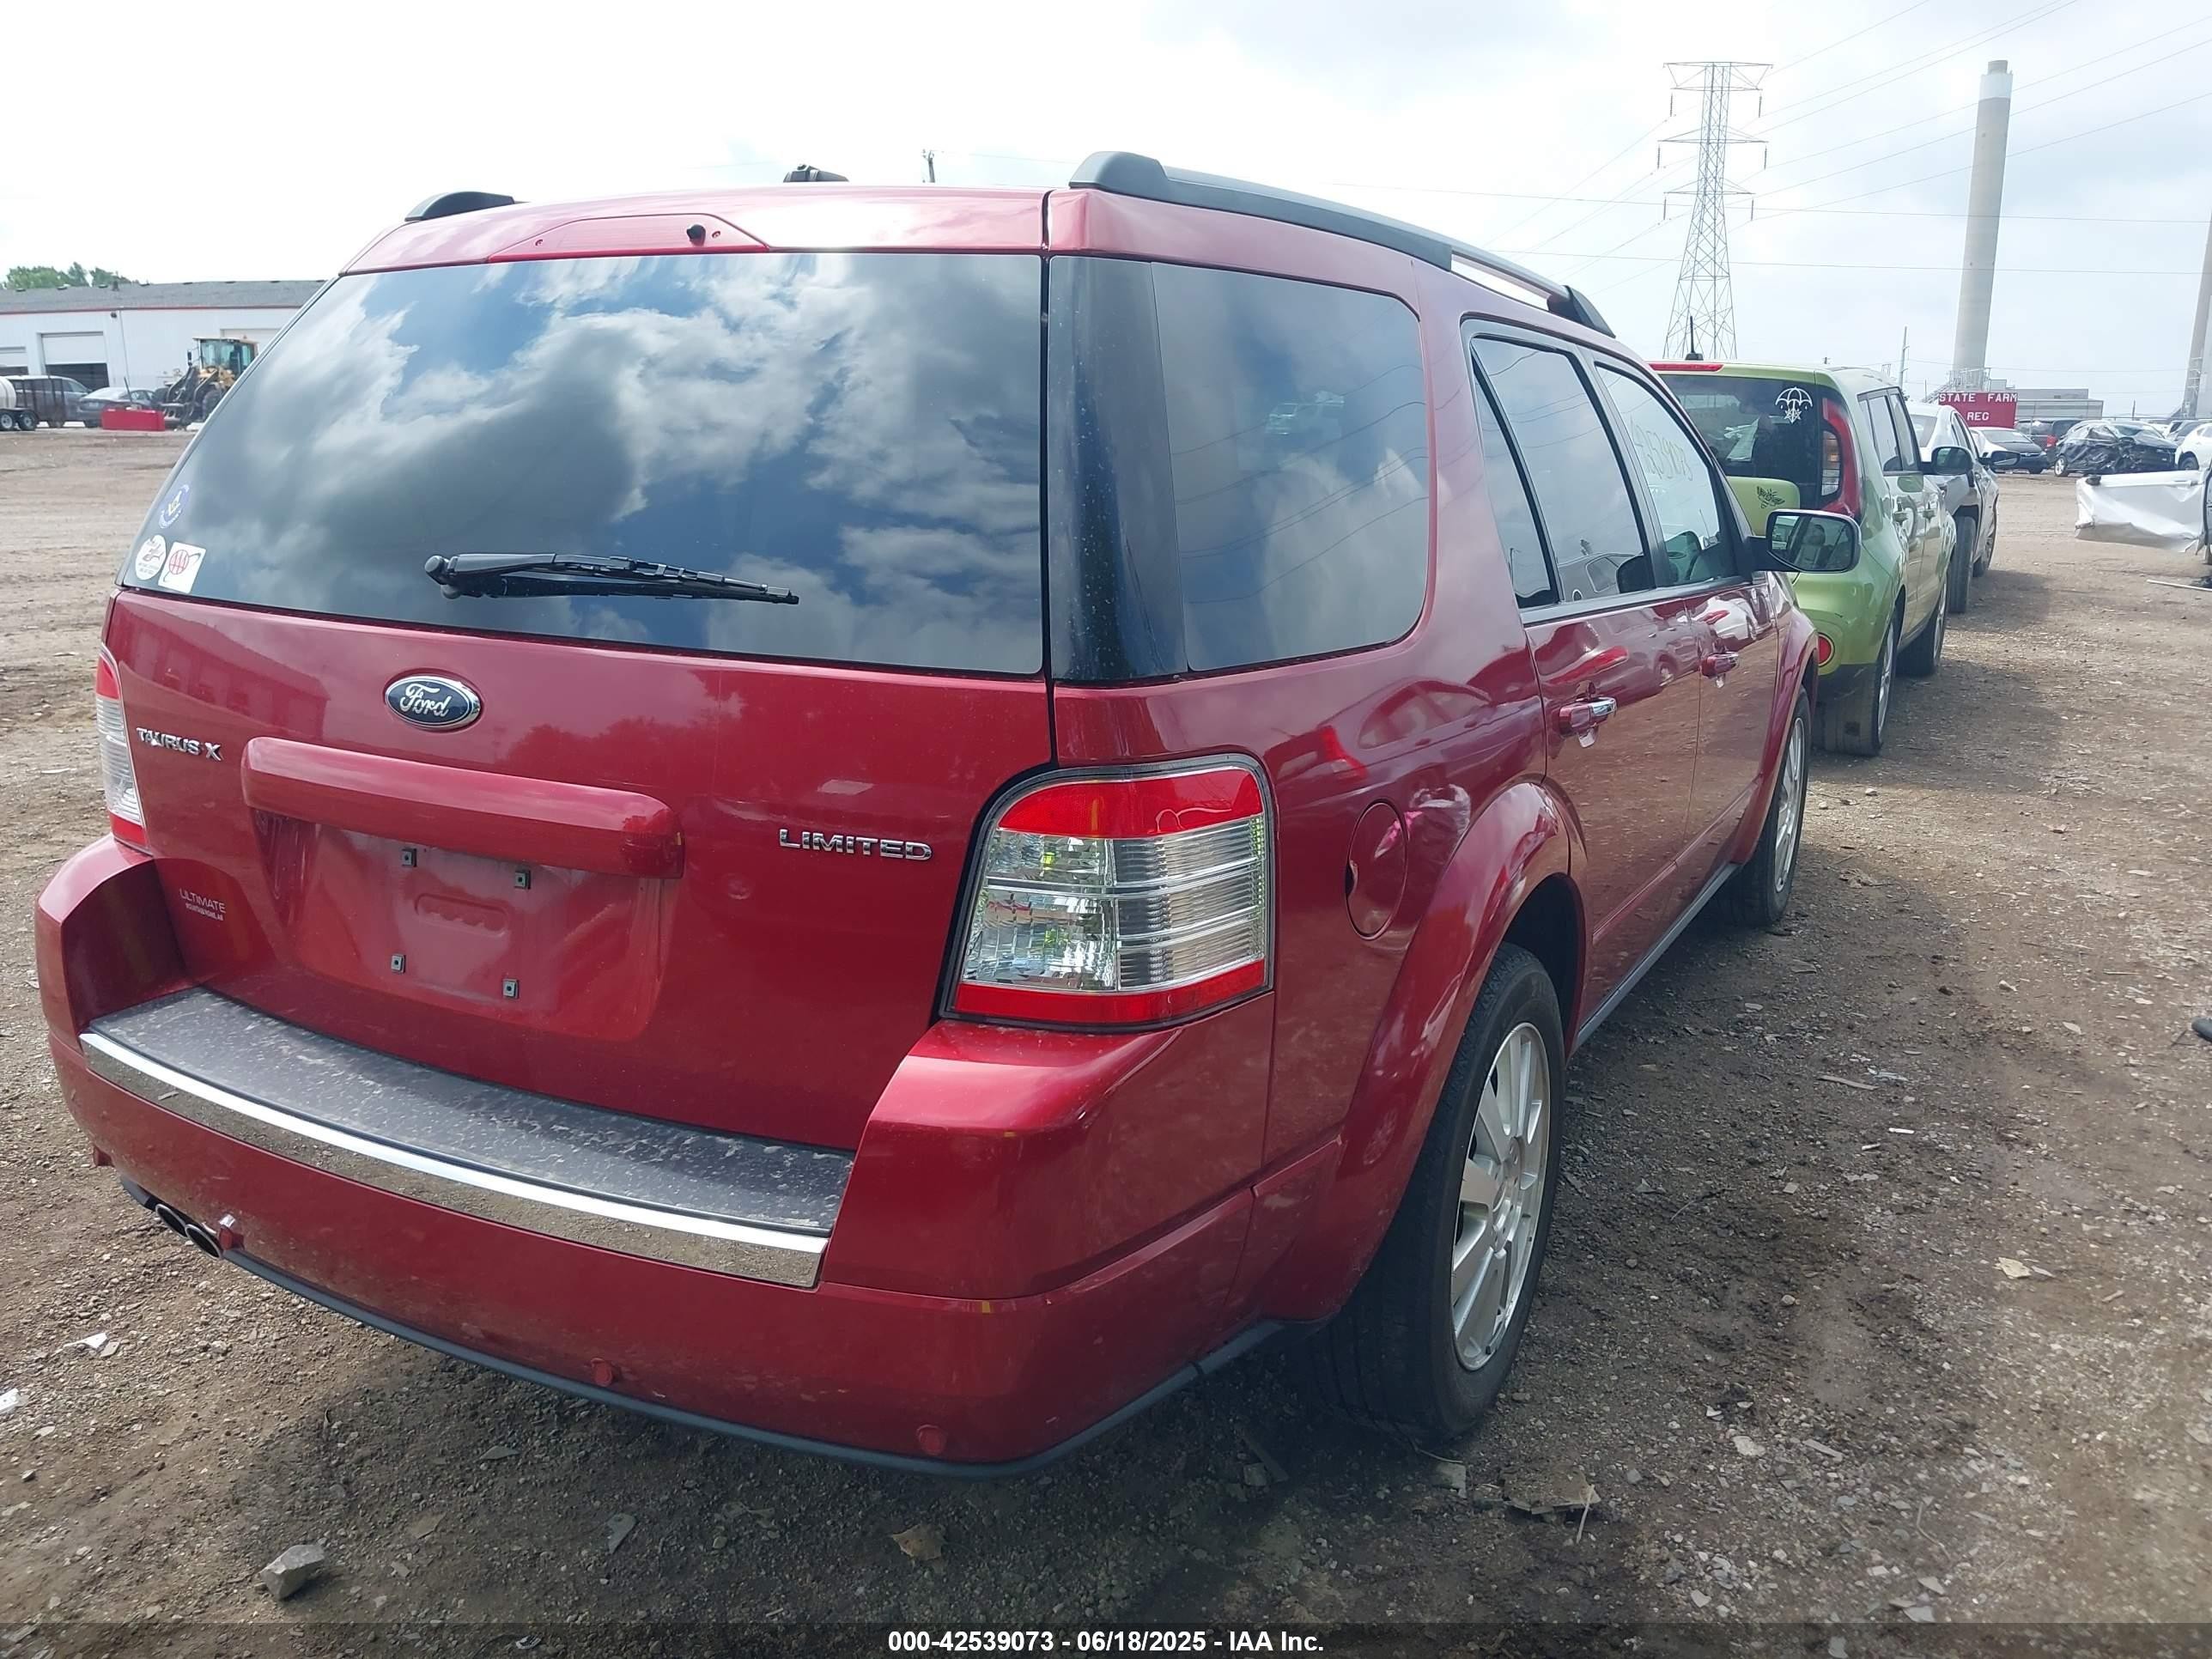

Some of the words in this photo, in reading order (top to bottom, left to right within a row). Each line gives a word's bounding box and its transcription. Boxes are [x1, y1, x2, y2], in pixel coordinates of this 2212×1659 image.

[1939, 393, 1976, 403] STATE
[1987, 393, 2018, 403] FARM
[399, 683, 453, 717] Ford
[136, 727, 201, 756] TAURUS
[205, 742, 222, 762] X
[779, 820, 933, 860] LIMITED
[179, 888, 227, 914] ULTIMATE
